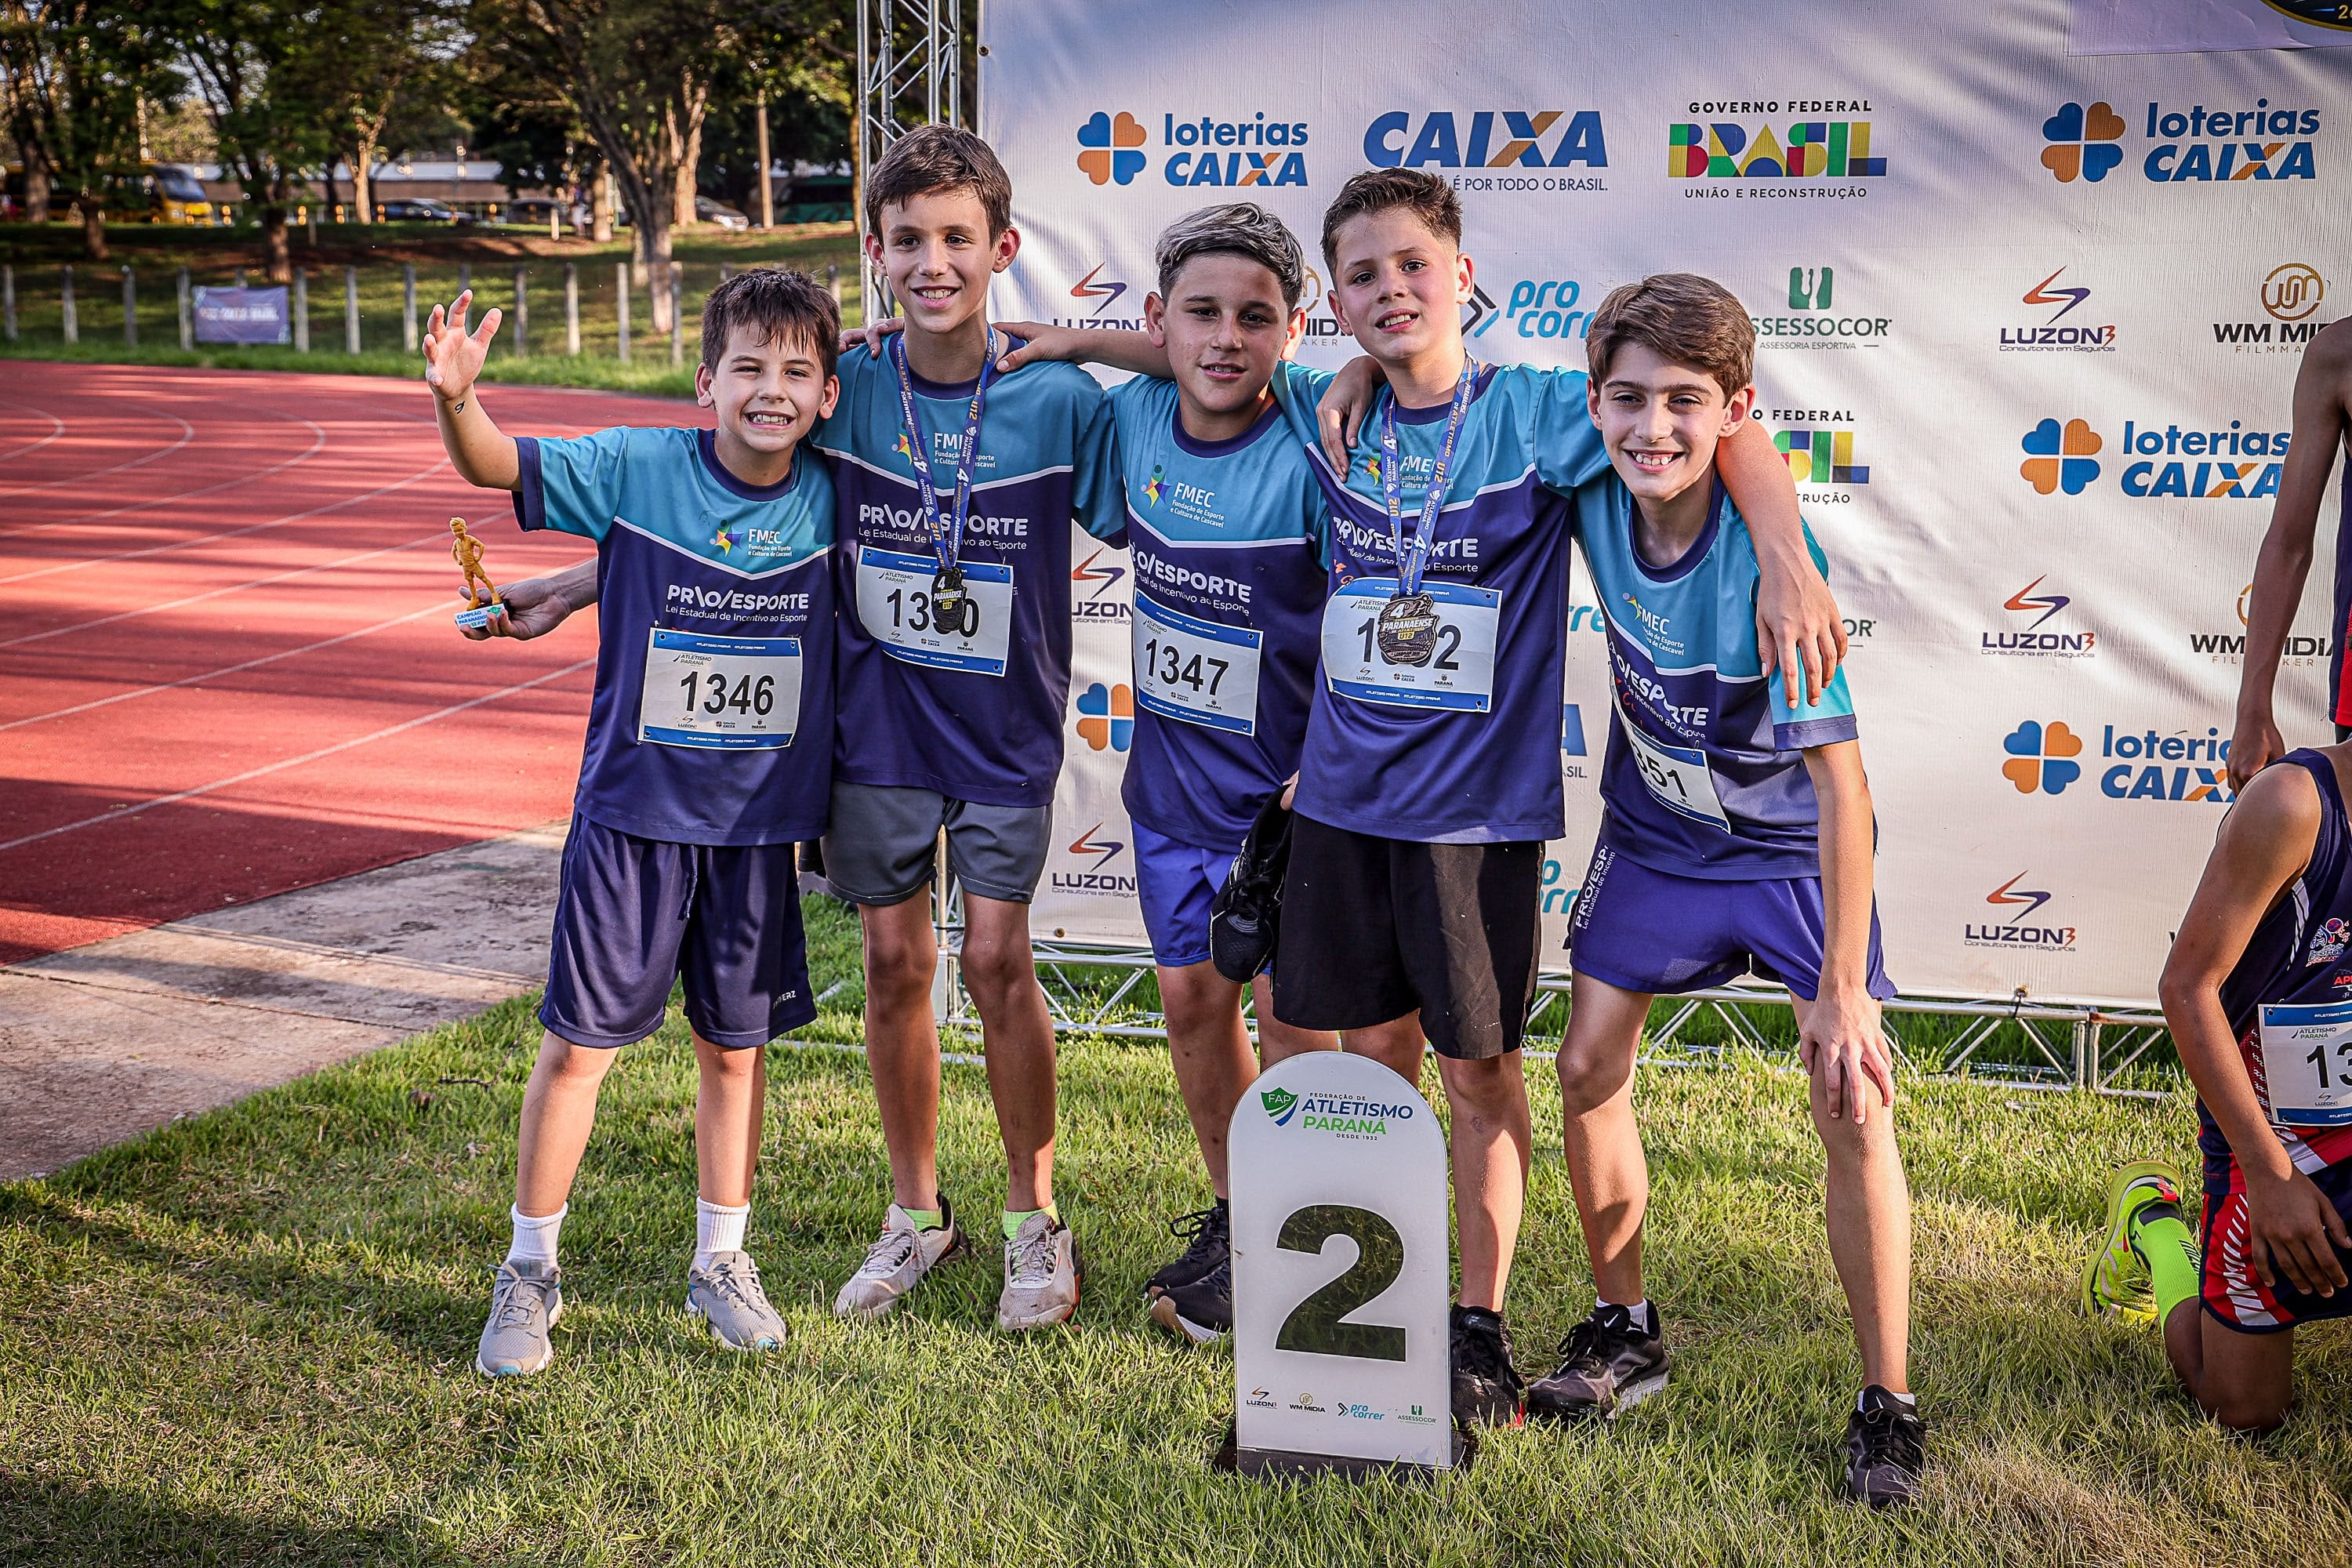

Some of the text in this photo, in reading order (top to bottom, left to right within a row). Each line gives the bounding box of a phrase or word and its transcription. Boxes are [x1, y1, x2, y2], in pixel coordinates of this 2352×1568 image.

[1689, 100, 1872, 114] GOVERNO FEDERAL
[2146, 98, 2321, 138] loterias
[1164, 111, 1308, 146] loterias
[1363, 111, 1609, 168] CAIXA
[1668, 122, 1887, 177] BRASIL
[1164, 152, 1308, 187] CAIXA
[2143, 142, 2316, 183] CAIXA
[1465, 178, 1493, 191] POR
[1497, 178, 1539, 191] TODO
[1543, 178, 1556, 191] O
[1559, 178, 1608, 191] BRASIL.
[1685, 186, 1867, 199] UNIÃO E RECONSTRUÇÃO
[1506, 280, 1581, 318] pro
[1518, 310, 1596, 339] corr
[1749, 318, 1889, 336] SSESSOCOR
[2213, 323, 2271, 343] WM
[1759, 341, 1857, 350] ASSESSORIA ESPORTIVA
[969, 400, 978, 420] U12
[1773, 409, 1855, 421] FEDERAL
[934, 432, 964, 450] FM
[1444, 410, 1459, 457] ATLETISMO
[2123, 420, 2292, 456] loterias
[1399, 455, 1436, 473] FME
[1773, 430, 1870, 484] SIL
[1434, 461, 1446, 483] U12
[2121, 461, 2284, 498] CAIXA
[1174, 481, 1215, 508] FMEC
[1172, 499, 1196, 512] Fundação
[1203, 510, 1225, 521] Esporte
[1388, 498, 1399, 517] U12
[1425, 500, 1436, 530] ATLETISMO
[1174, 508, 1193, 519] Cultura
[1200, 517, 1225, 528] Cascavel
[748, 528, 782, 544] FMEC
[858, 526, 871, 537] Lei
[873, 528, 912, 542] Estadual
[913, 533, 927, 543] de
[978, 538, 992, 546] ao
[930, 522, 942, 541] U12
[884, 572, 913, 580] ATLETISMO
[1433, 562, 1479, 572] Esporte
[1150, 579, 1158, 590] de
[666, 604, 678, 614] Lei
[679, 607, 718, 619] Estadual
[719, 612, 731, 621] de
[733, 613, 768, 622] Incentivo
[780, 614, 808, 623] Esporte
[887, 588, 979, 638] 130
[1381, 618, 1435, 632] PARANAENSE
[1357, 618, 1461, 671] 12
[1658, 643, 1685, 656] Cascavel
[1661, 636, 1685, 648] Esporte
[2190, 634, 2246, 655] WM
[1145, 637, 1229, 698] 1347
[681, 670, 775, 716] 1346
[1665, 718, 1677, 730] ao
[2103, 725, 2232, 762] loteri
[1631, 739, 1688, 798] 351
[2101, 764, 2236, 803] CAIX
[1601, 851, 1616, 877] Incenti
[1052, 873, 1136, 891] LUZON
[1598, 877, 1605, 887] de
[1585, 887, 1601, 918] Estadual
[1964, 939, 2017, 949] Consultoria
[2035, 943, 2076, 953] Seguros
[1269, 1094, 1291, 1104] FAP
[1301, 1098, 1414, 1120] ATLETISMO
[1303, 1116, 1387, 1135] PARANÁ
[1275, 1203, 1406, 1363] 2
[1350, 1404, 1369, 1413] pro
[1353, 1411, 1385, 1421] correr
[1397, 1414, 1437, 1423] ASSESSOCOR
